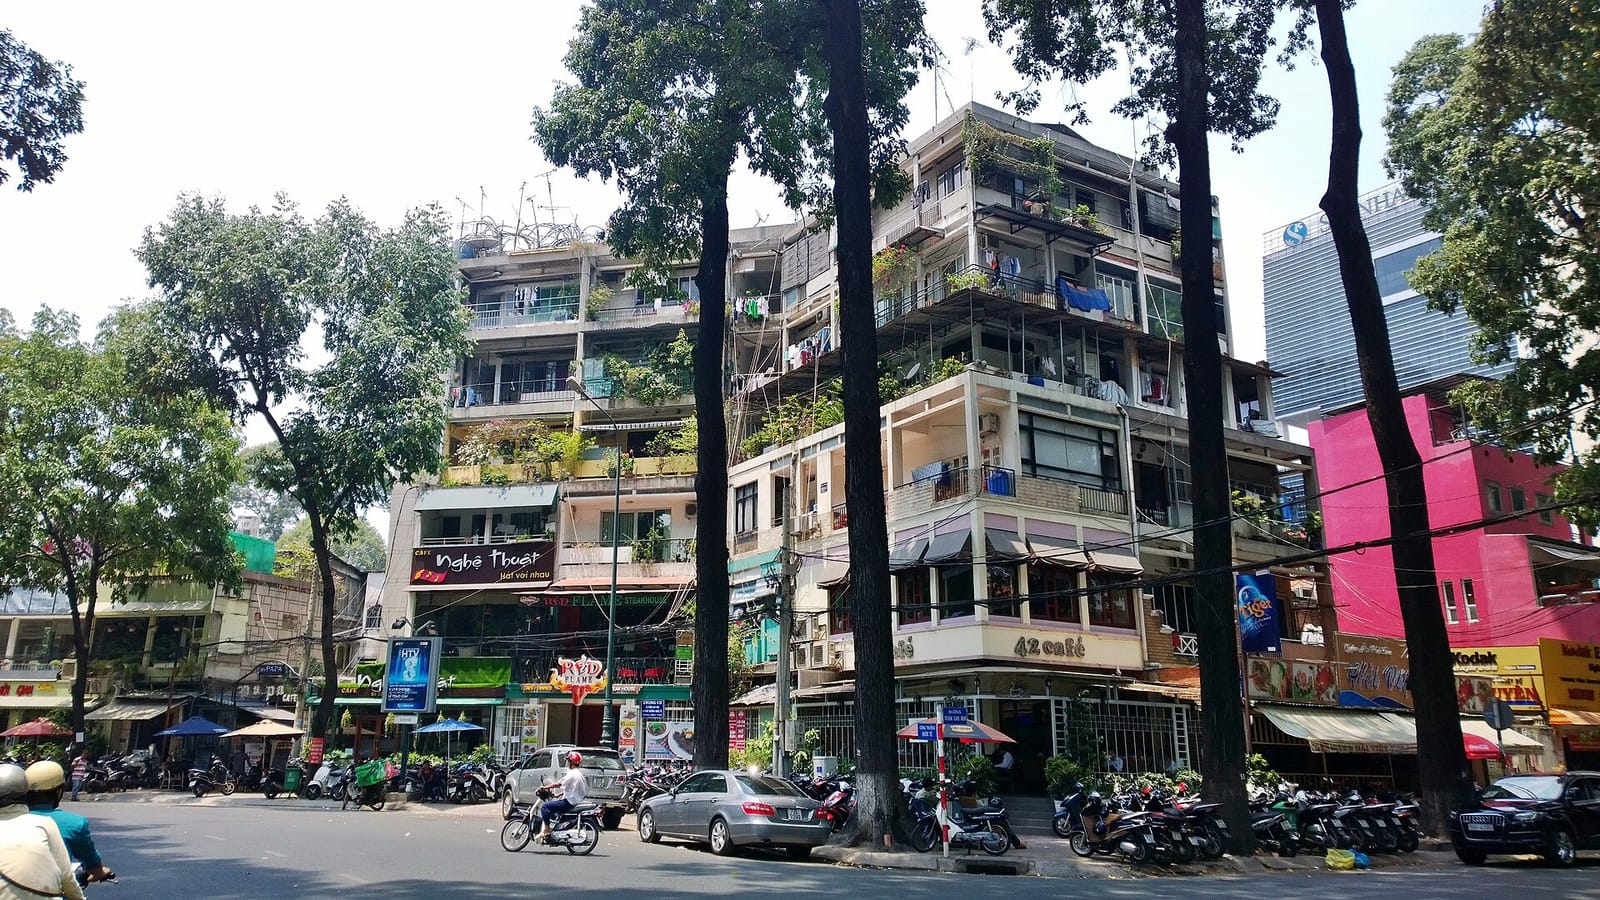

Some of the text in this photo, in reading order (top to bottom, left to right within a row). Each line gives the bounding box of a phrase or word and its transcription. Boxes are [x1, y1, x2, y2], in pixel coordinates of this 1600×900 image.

[436, 549, 540, 572] Nghệ Thuật
[530, 571, 550, 579] nhau
[1239, 599, 1272, 619] Tiger
[1013, 636, 1086, 658] 42 café
[559, 656, 602, 676] RED
[1452, 651, 1498, 665] Kodak
[564, 676, 593, 684] FLAME
